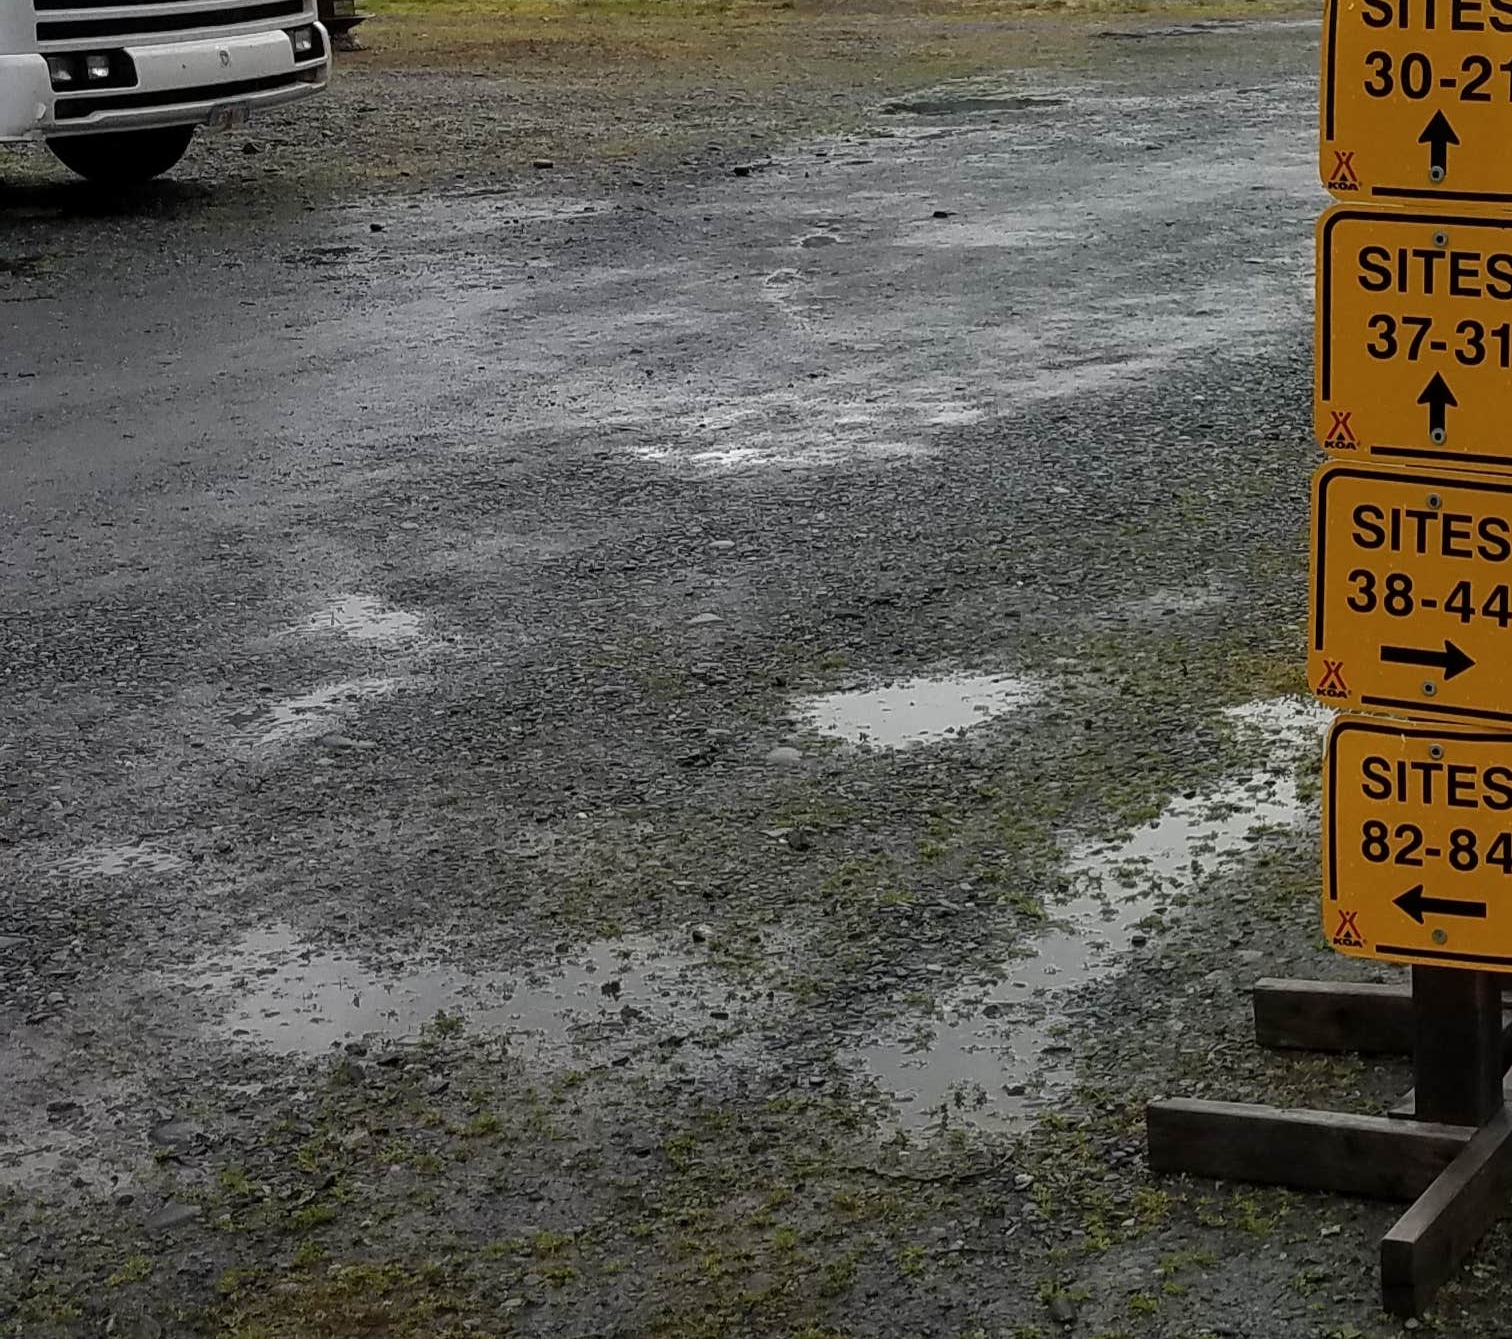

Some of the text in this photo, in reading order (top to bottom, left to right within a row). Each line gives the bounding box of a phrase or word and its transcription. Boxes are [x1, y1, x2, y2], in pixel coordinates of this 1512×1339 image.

[1328, 181, 1359, 191] KOA
[1367, 314, 1510, 368] 37-31
[1324, 440, 1357, 450] KOA
[1352, 504, 1511, 562] SITES
[1347, 569, 1512, 628] 38-44
[1316, 688, 1348, 699] KOA
[1333, 937, 1363, 948] KOA
